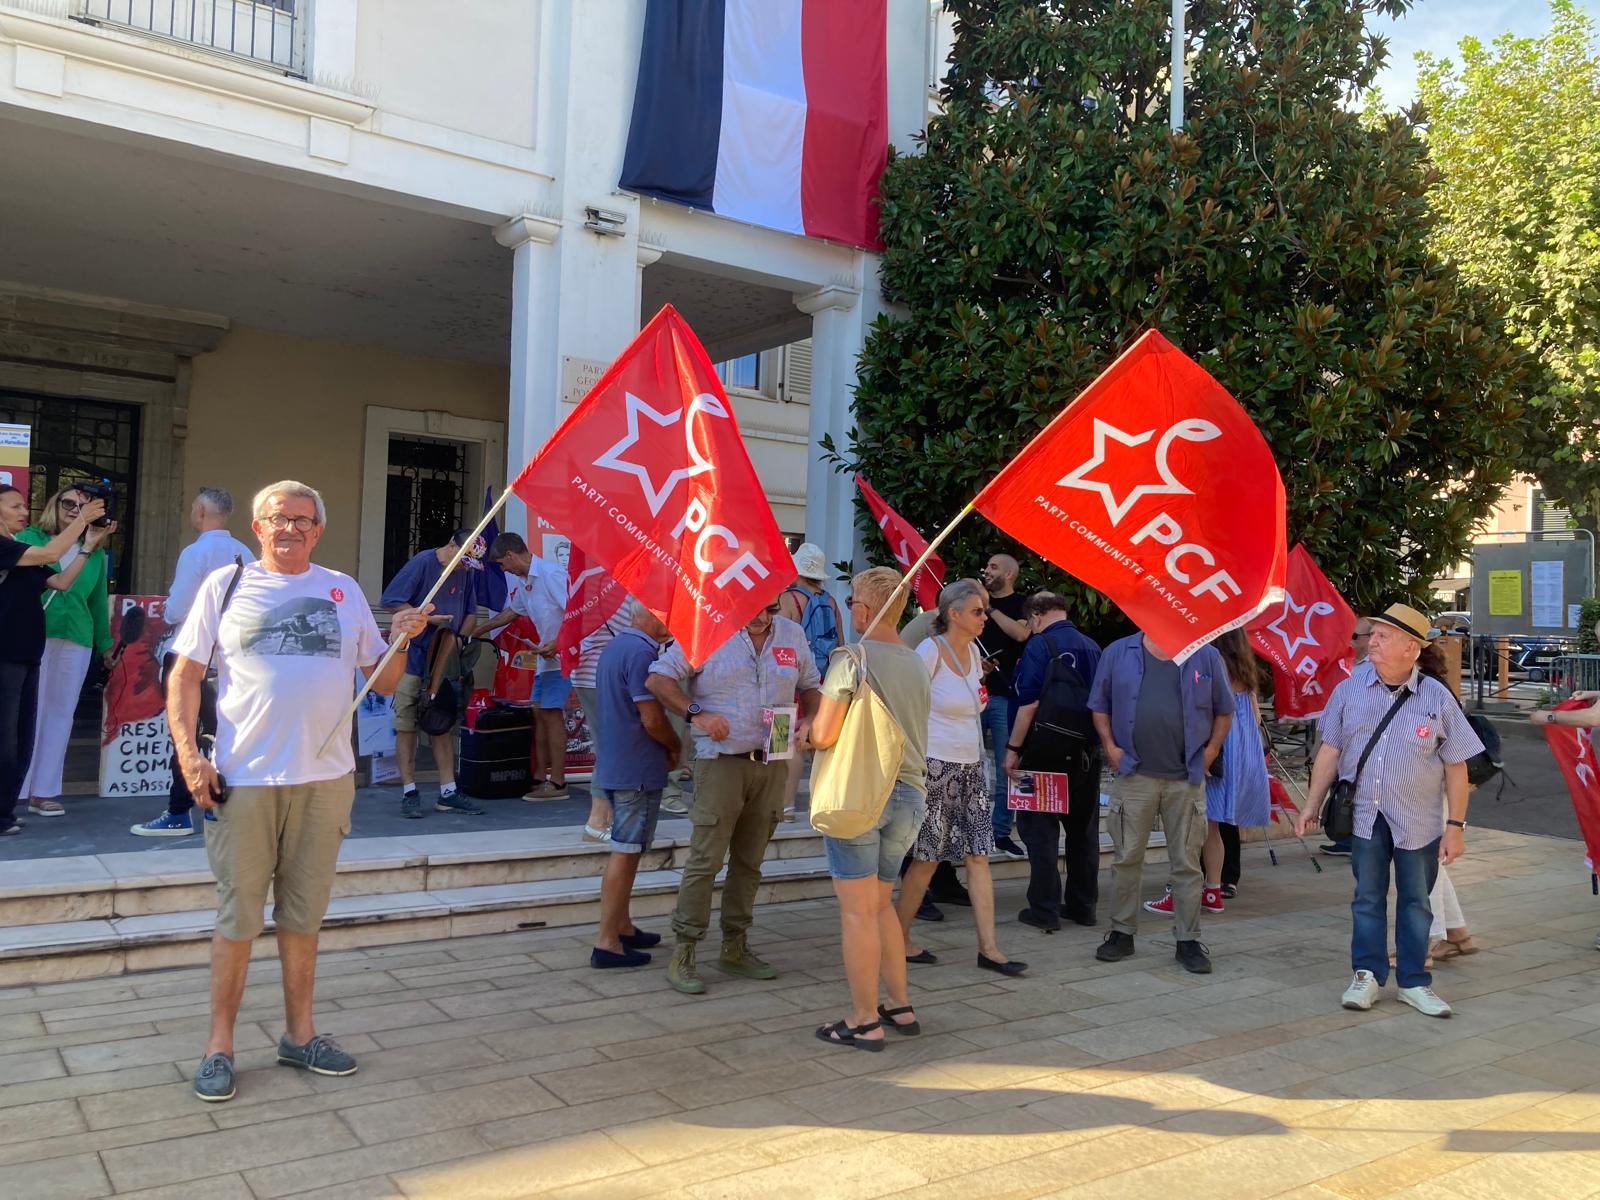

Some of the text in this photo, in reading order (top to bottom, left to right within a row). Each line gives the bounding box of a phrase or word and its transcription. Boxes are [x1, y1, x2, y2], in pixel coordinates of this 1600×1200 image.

[576, 376, 600, 385] GEO
[583, 363, 609, 375] PARV
[572, 476, 725, 624] PARTI COMMUNISTE FRANÇAIS
[670, 497, 770, 591] PCF
[1034, 495, 1199, 624] PARTI COMMUNISTE FRANÇAIS
[1129, 511, 1242, 604] PCF
[1255, 631, 1270, 650] PARTI
